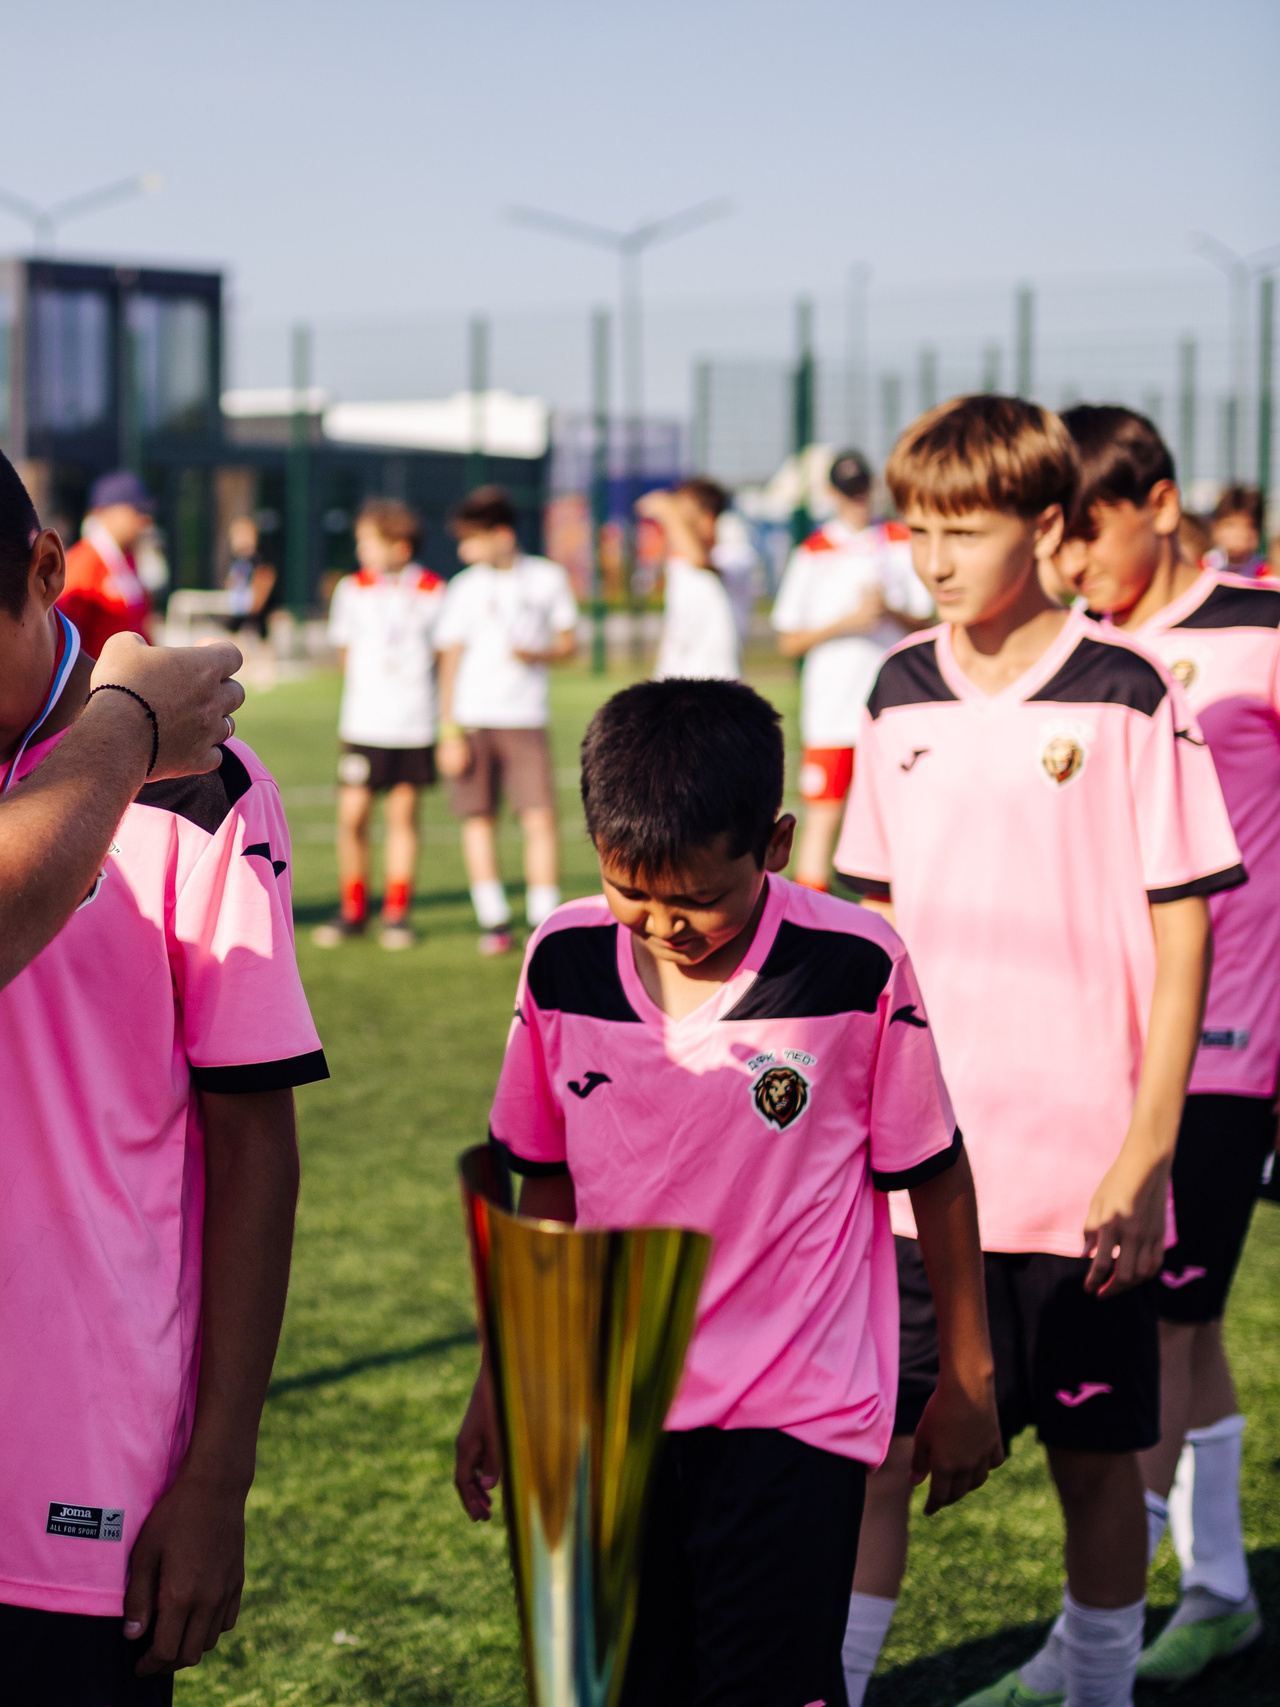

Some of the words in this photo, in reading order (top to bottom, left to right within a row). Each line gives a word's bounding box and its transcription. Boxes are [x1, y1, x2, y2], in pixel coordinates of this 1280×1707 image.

[50, 1523, 62, 1532] ALL
[63, 1525, 76, 1534] FOR
[77, 1527, 98, 1536] SPORT
[103, 1529, 120, 1538] 1965
